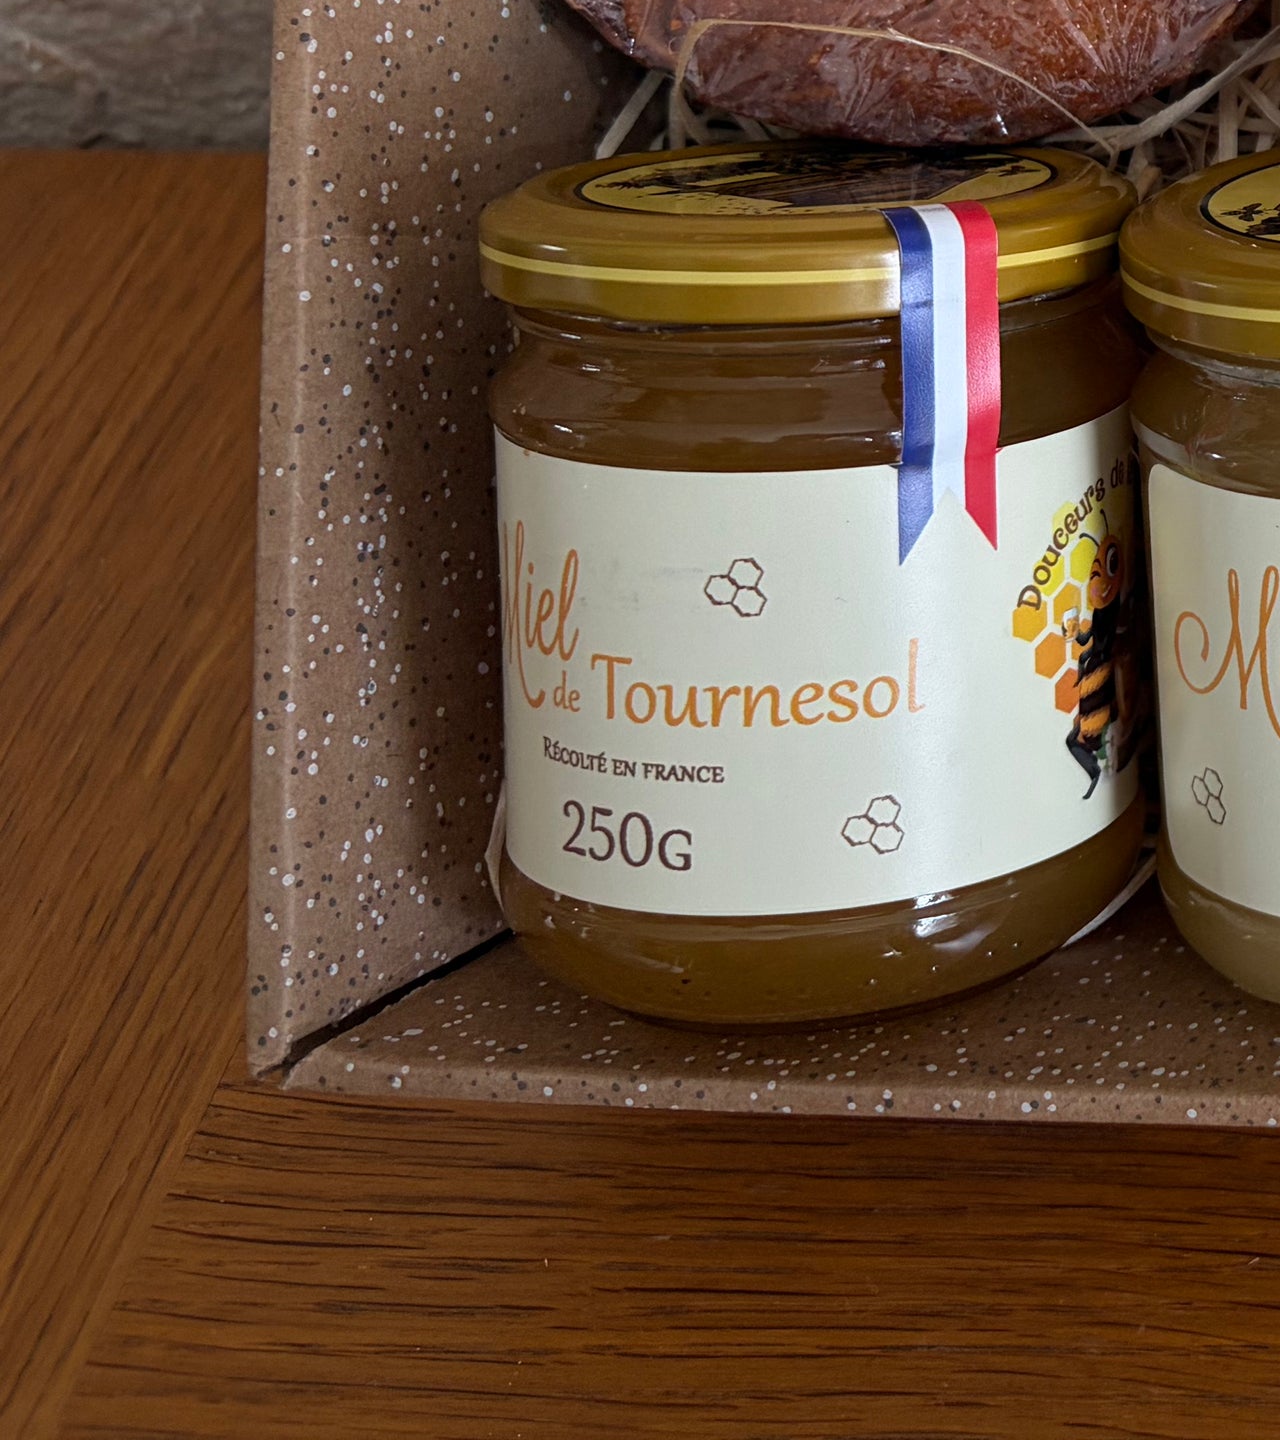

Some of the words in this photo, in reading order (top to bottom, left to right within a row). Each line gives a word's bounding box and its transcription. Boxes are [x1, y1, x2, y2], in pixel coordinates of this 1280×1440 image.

[1017, 477, 1105, 611] Douceurs
[553, 670, 581, 713] de
[590, 638, 927, 729] Tournesol
[542, 735, 607, 774] RÉCOLTÉ
[611, 758, 637, 779] EN
[641, 762, 725, 784] FRANCE
[561, 799, 693, 872] 250G
